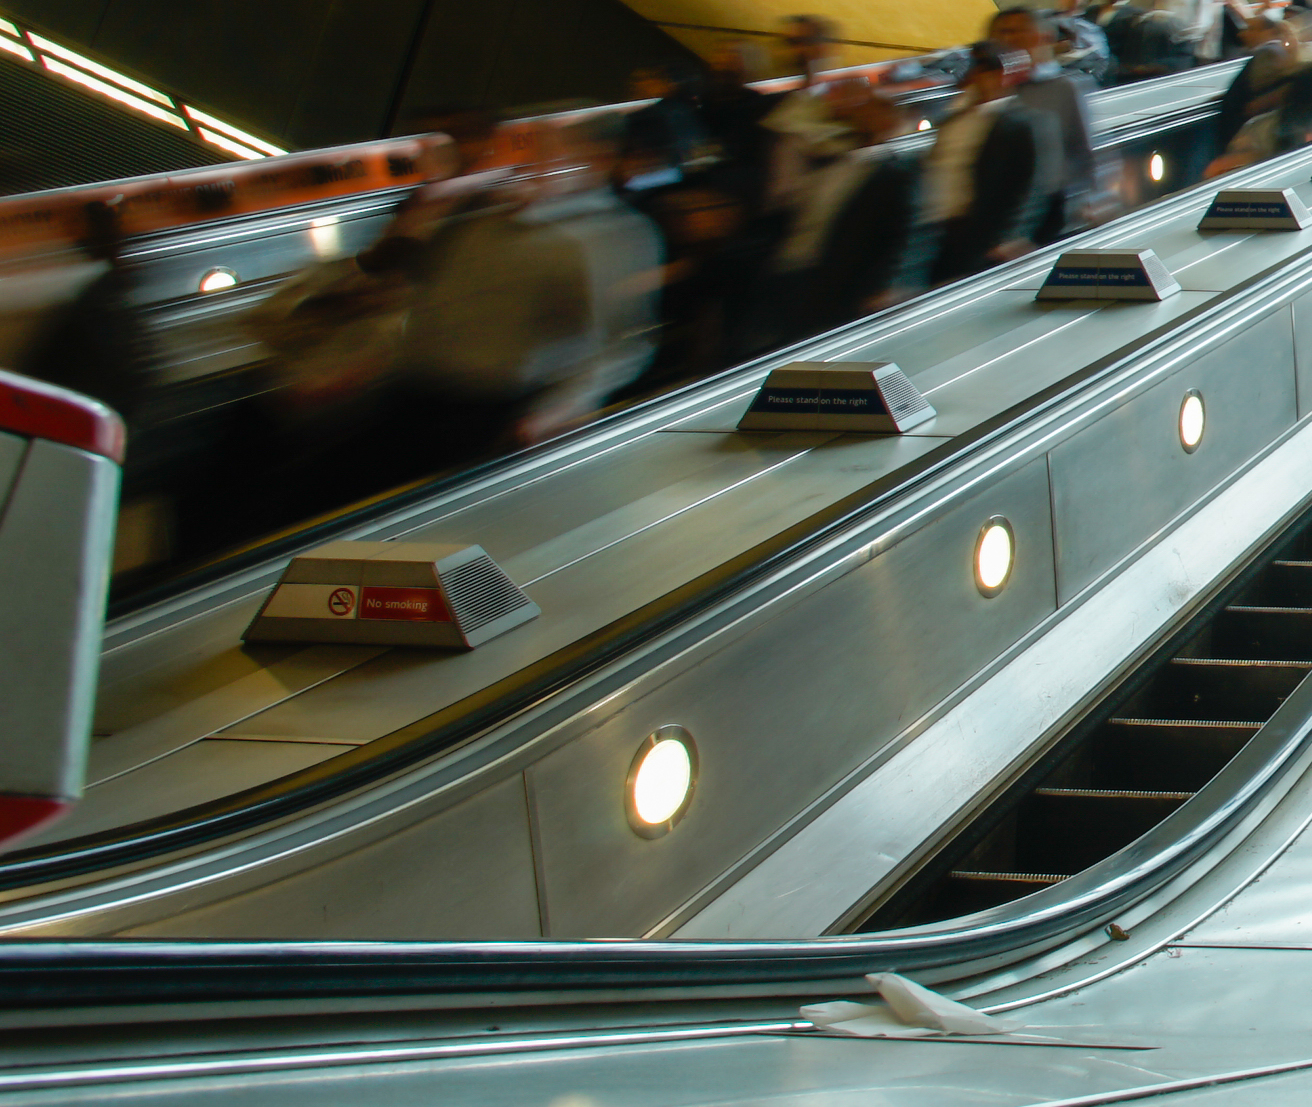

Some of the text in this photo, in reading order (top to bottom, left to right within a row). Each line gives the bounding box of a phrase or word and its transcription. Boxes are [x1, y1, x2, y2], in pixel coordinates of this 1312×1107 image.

[768, 395, 794, 404] Please
[796, 396, 819, 404] stand
[850, 398, 867, 407] right
[366, 598, 428, 612] No smoking
